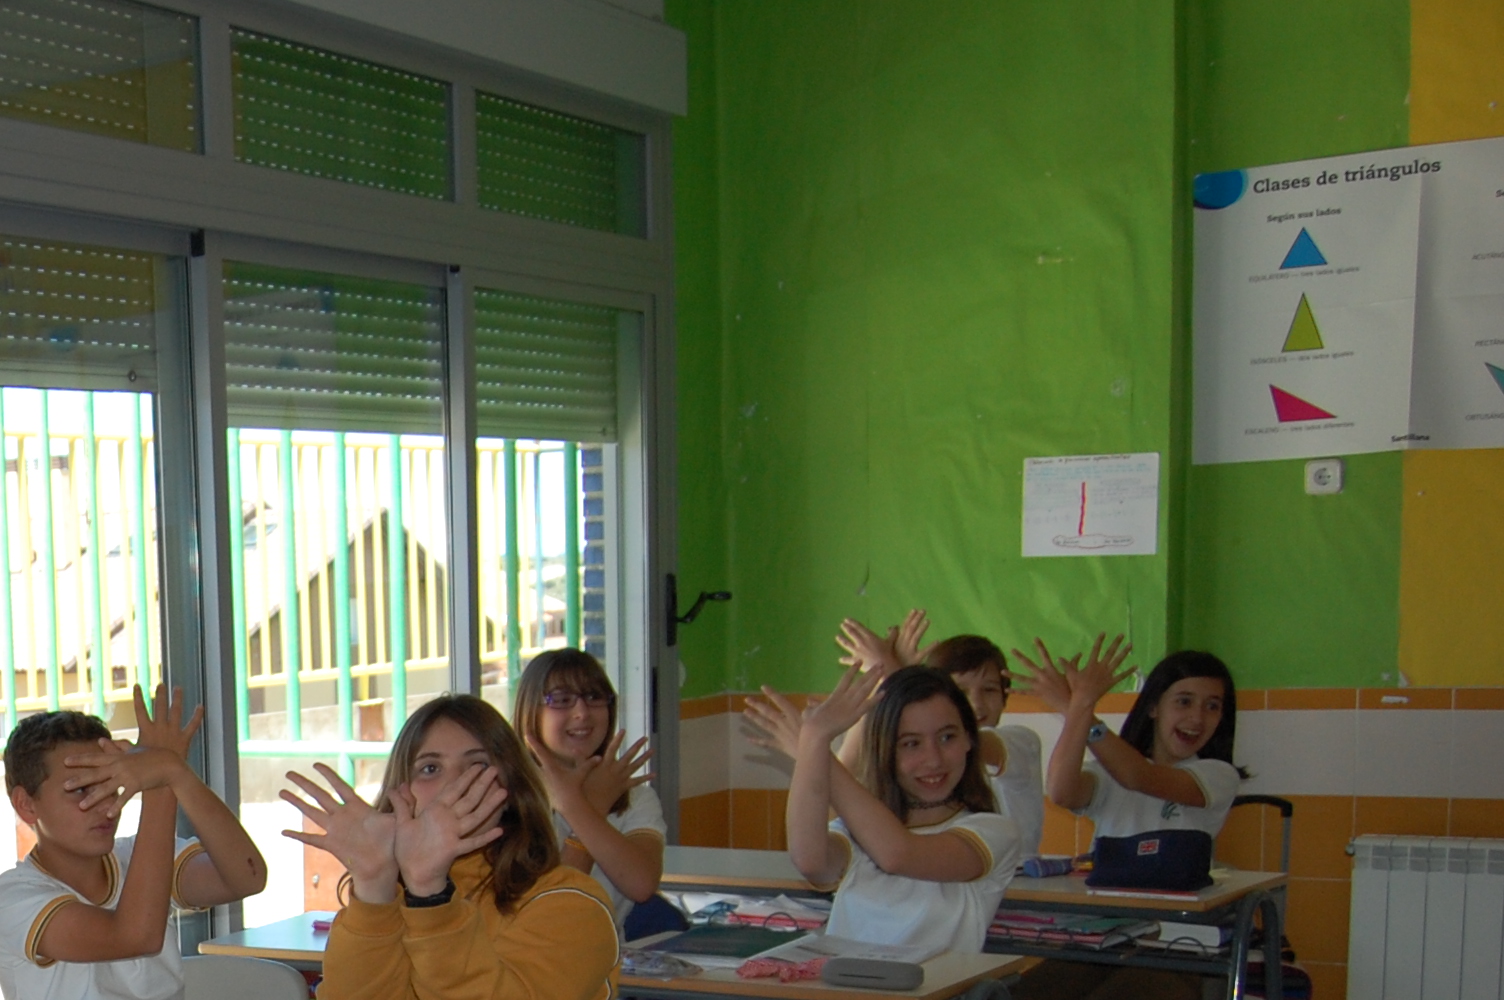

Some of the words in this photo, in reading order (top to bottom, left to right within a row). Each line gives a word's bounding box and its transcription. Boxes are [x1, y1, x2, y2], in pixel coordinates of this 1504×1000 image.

[1253, 175, 1310, 194] Clases
[1316, 170, 1338, 186] de
[1344, 158, 1442, 182] triángulos
[1266, 213, 1296, 223] Según
[1298, 211, 1314, 220] sus
[1316, 207, 1342, 218] lados
